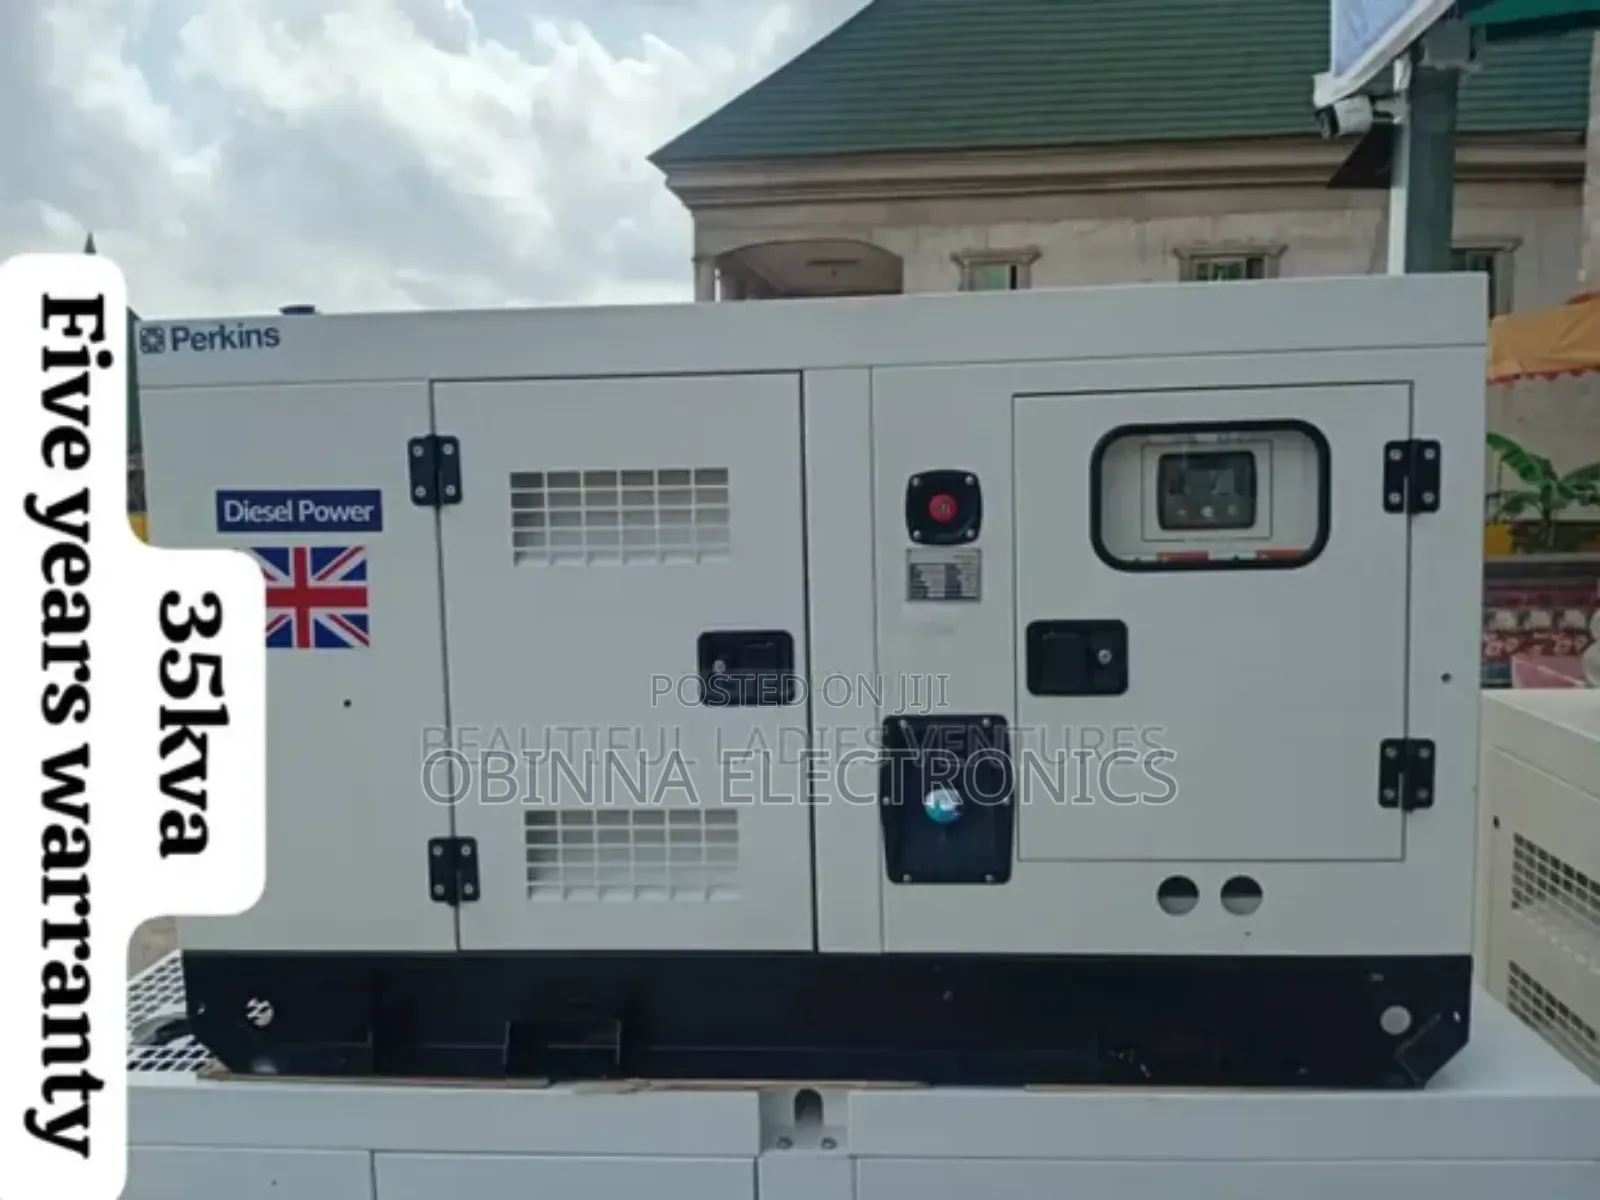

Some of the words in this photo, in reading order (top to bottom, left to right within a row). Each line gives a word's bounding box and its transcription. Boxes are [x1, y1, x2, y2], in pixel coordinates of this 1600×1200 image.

[170, 322, 281, 351] Perkins
[224, 499, 293, 523] Diesel
[298, 499, 375, 523] Power
